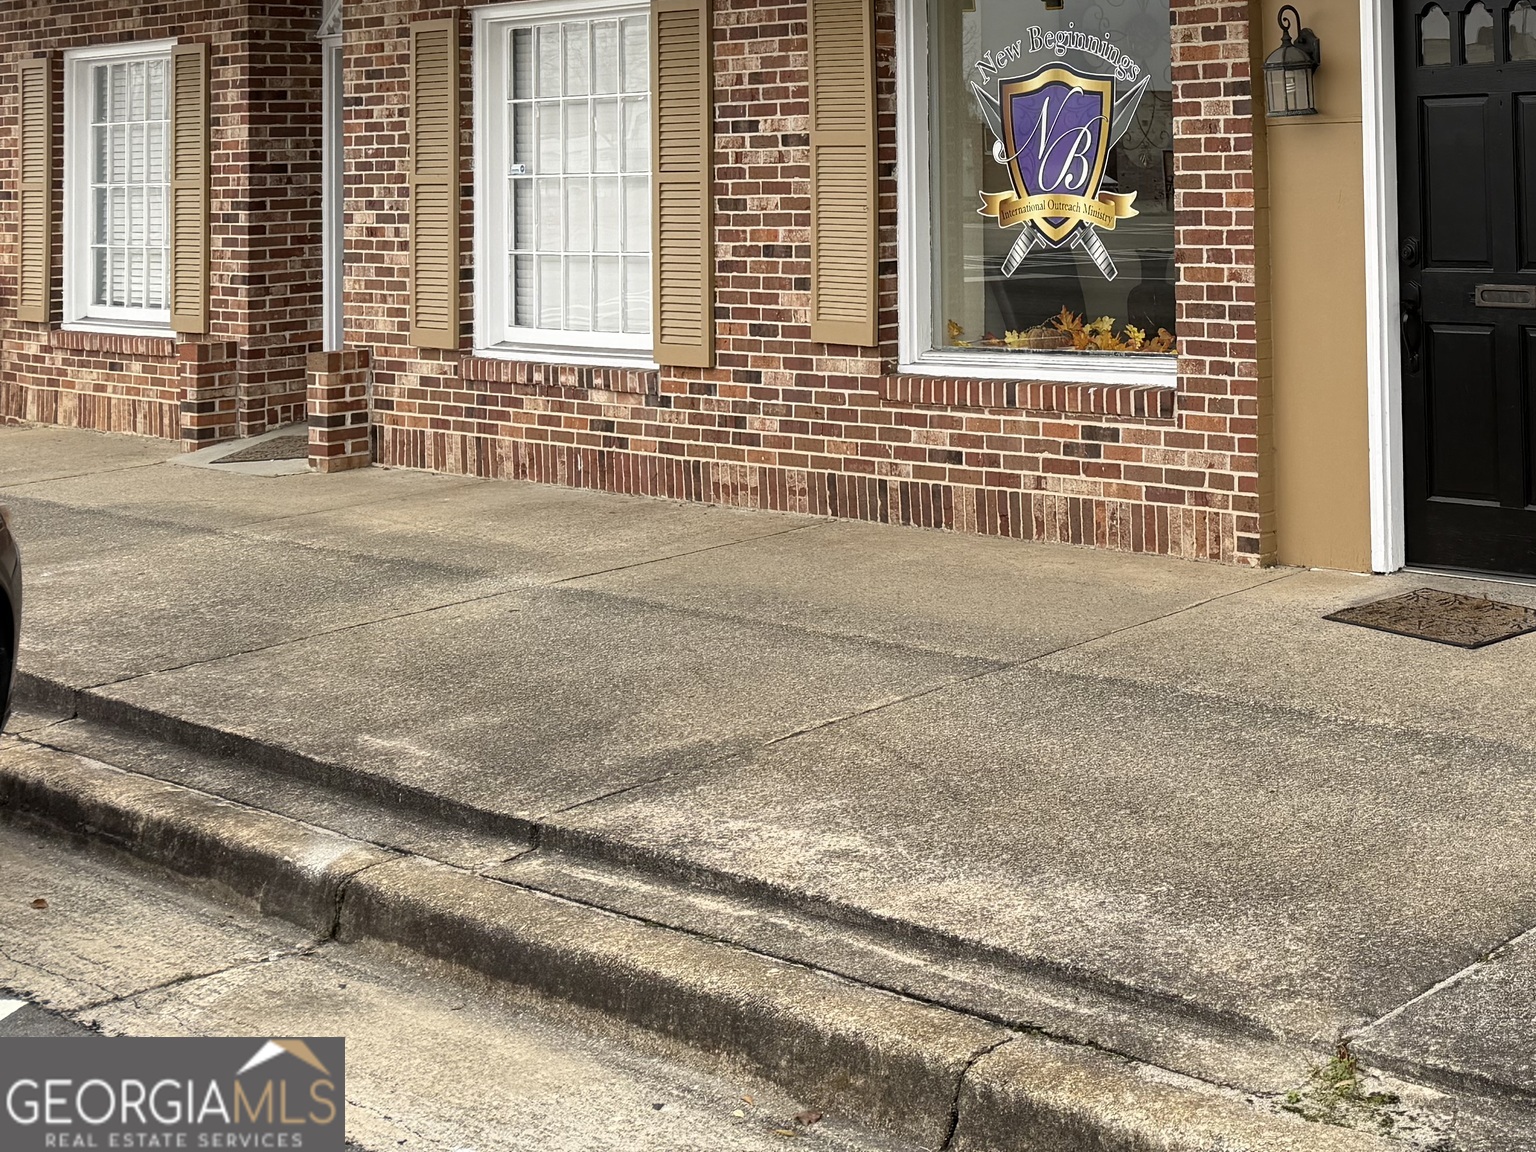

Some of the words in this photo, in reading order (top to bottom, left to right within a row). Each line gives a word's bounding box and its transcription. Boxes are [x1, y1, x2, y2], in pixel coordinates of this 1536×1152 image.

[975, 40, 1022, 85] New
[1027, 21, 1141, 82] Beginnings
[1001, 199, 1046, 220] International
[1047, 199, 1081, 213] Outreach
[1082, 203, 1114, 225] Ministry
